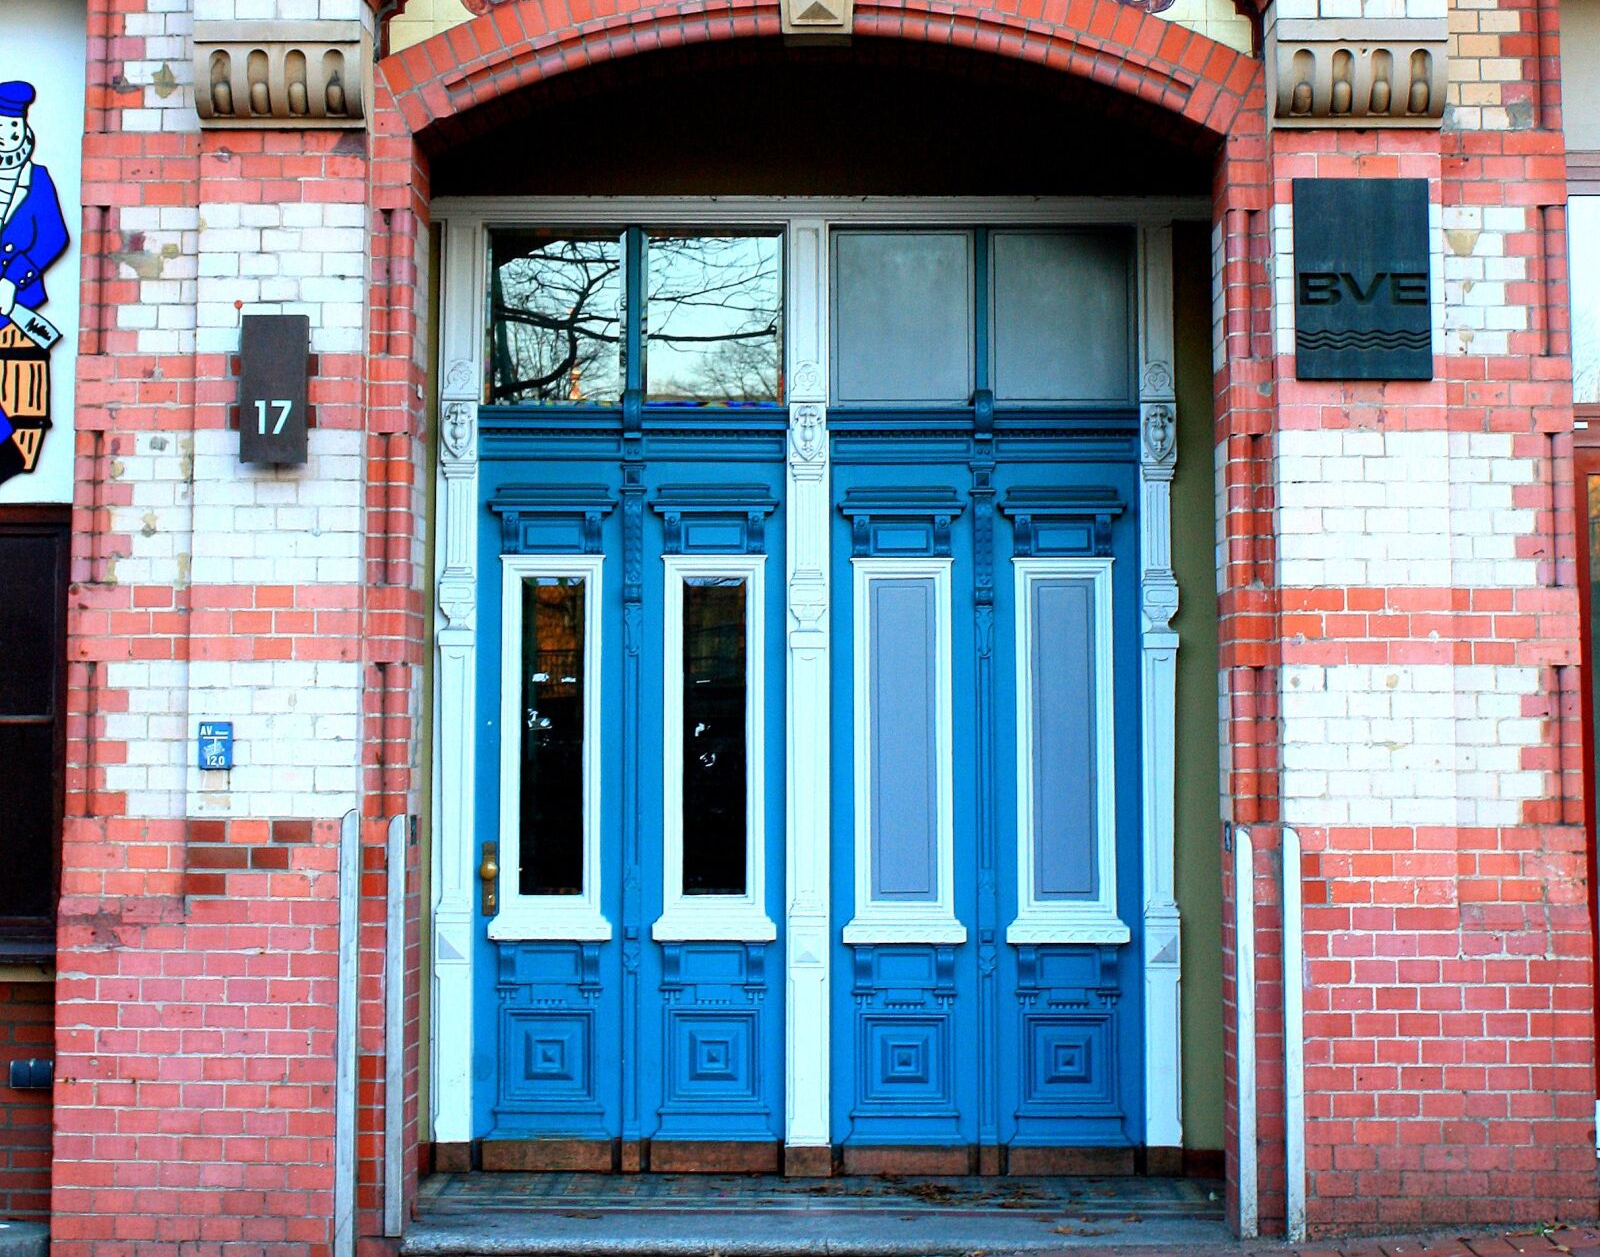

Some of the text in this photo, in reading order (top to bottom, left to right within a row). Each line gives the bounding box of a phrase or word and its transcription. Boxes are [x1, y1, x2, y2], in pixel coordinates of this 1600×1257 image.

[1299, 272, 1428, 305] BVE
[254, 400, 292, 435] 17
[200, 725, 213, 736] AV
